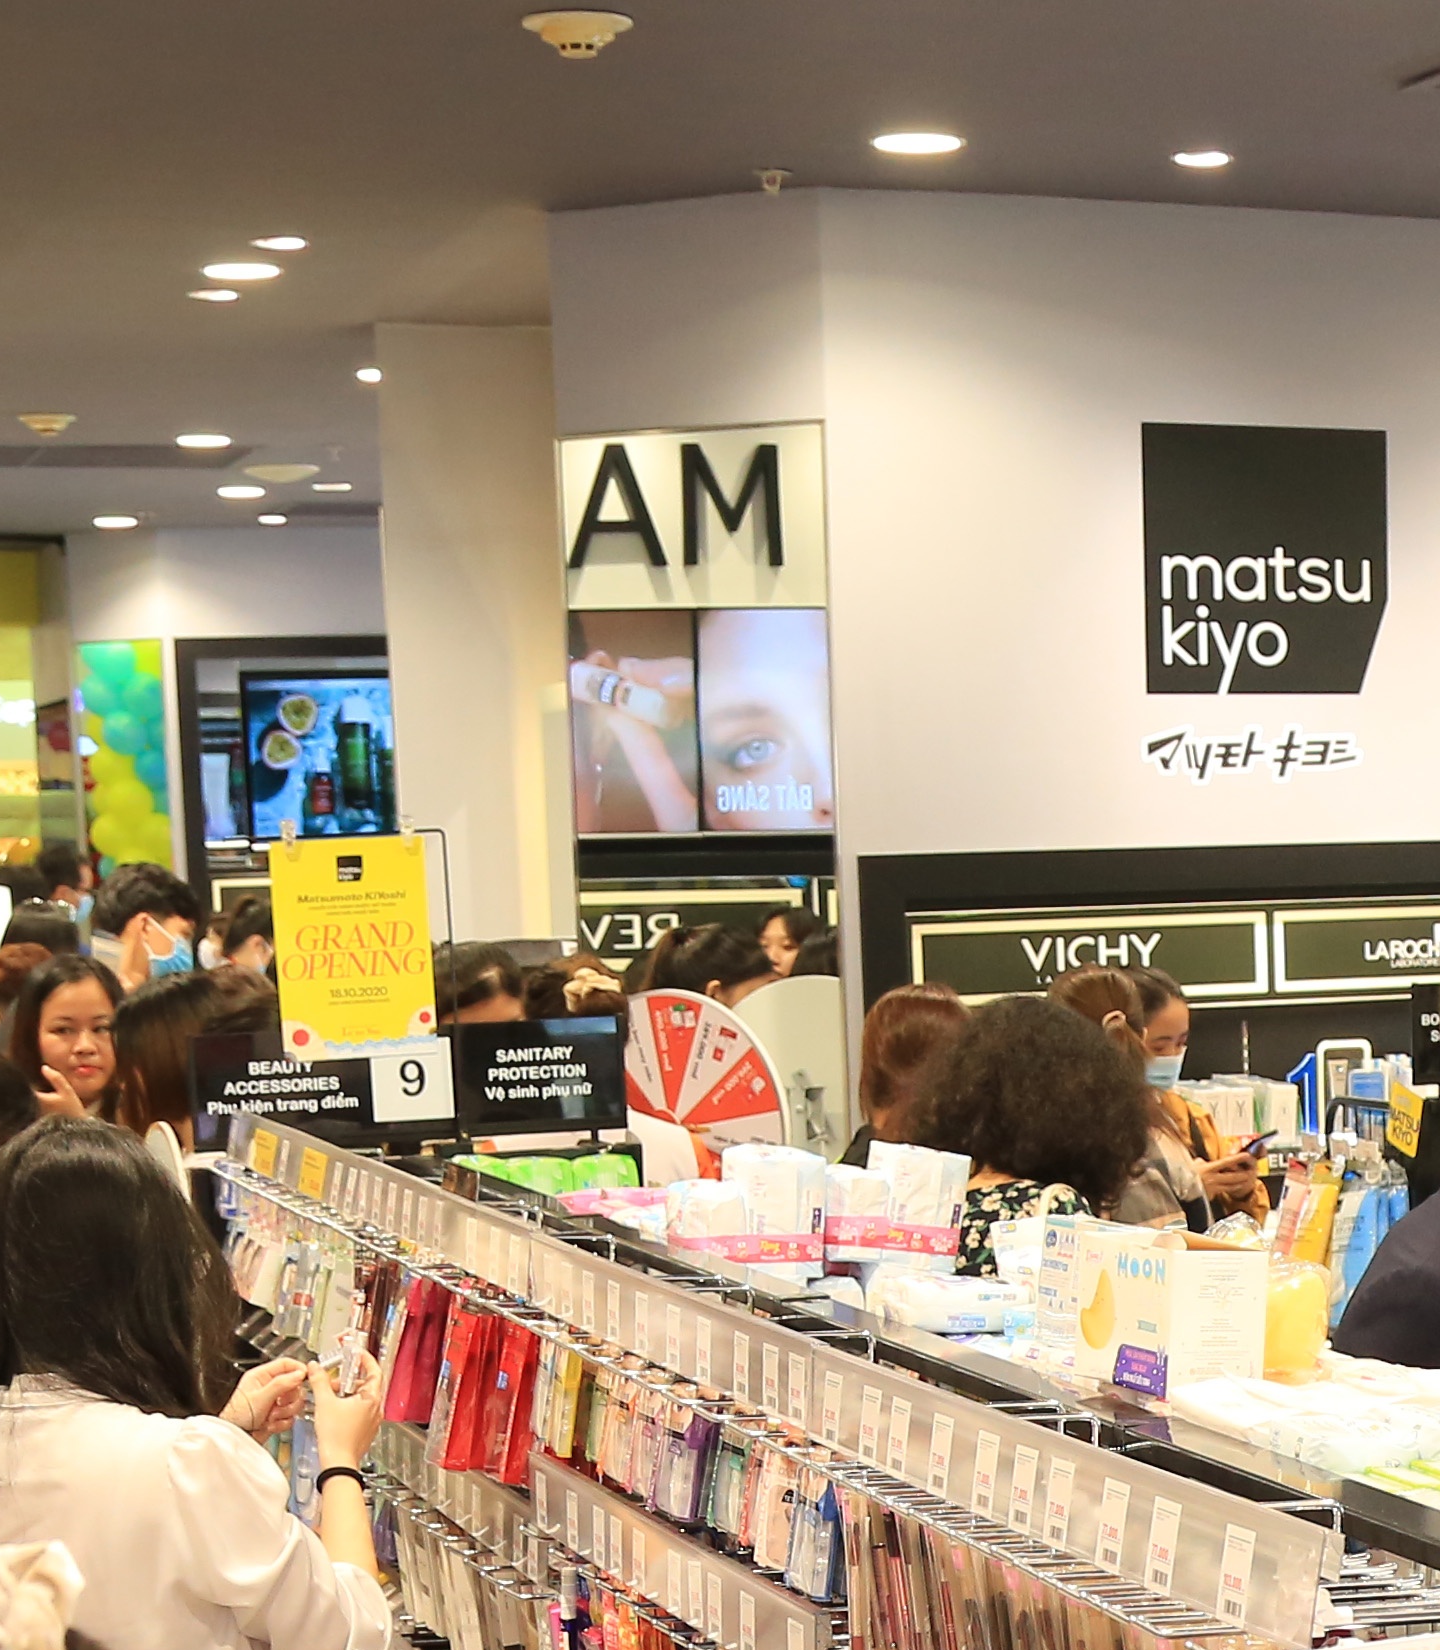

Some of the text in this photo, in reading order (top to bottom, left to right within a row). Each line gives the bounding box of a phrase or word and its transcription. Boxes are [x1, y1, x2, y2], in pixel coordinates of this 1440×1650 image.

[1161, 547, 1372, 603] matsu
[1161, 606, 1288, 695] kiyo
[295, 920, 415, 952] GRAND
[282, 948, 427, 981] OPENING
[1020, 931, 1162, 973] VICHY
[329, 986, 388, 999] 18.10.2020
[248, 1060, 314, 1076] BEAUTY
[495, 1046, 573, 1063] SANITARY
[224, 1077, 340, 1096] ACCESSORIES
[399, 1058, 427, 1097] 9
[487, 1063, 587, 1082] PROTECTION
[275, 1096, 320, 1114] trang
[321, 1090, 360, 1109] điểm
[485, 1079, 593, 1102] Vệ sinh phụ nữ
[1116, 1252, 1167, 1286] MOON
